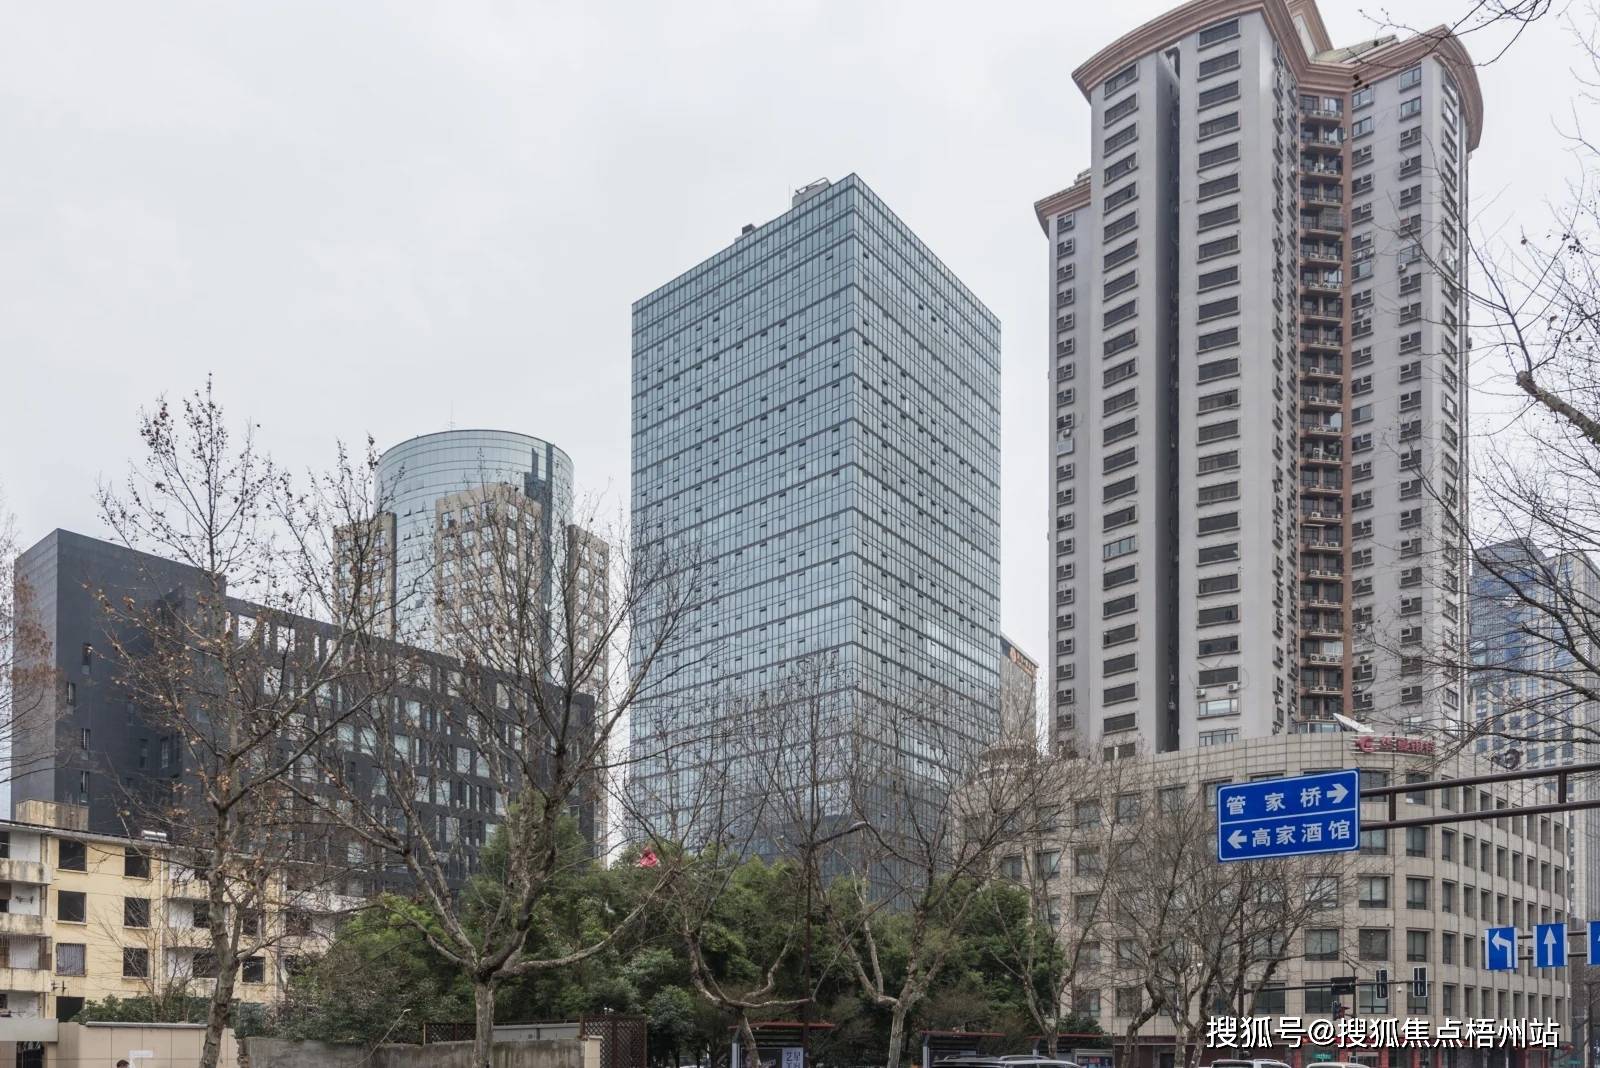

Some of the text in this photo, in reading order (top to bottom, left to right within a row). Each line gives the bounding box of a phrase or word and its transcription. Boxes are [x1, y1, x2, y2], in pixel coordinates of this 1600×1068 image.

[1226, 786, 1321, 816] 管家桥
[1251, 819, 1350, 848] 高家酒馆
